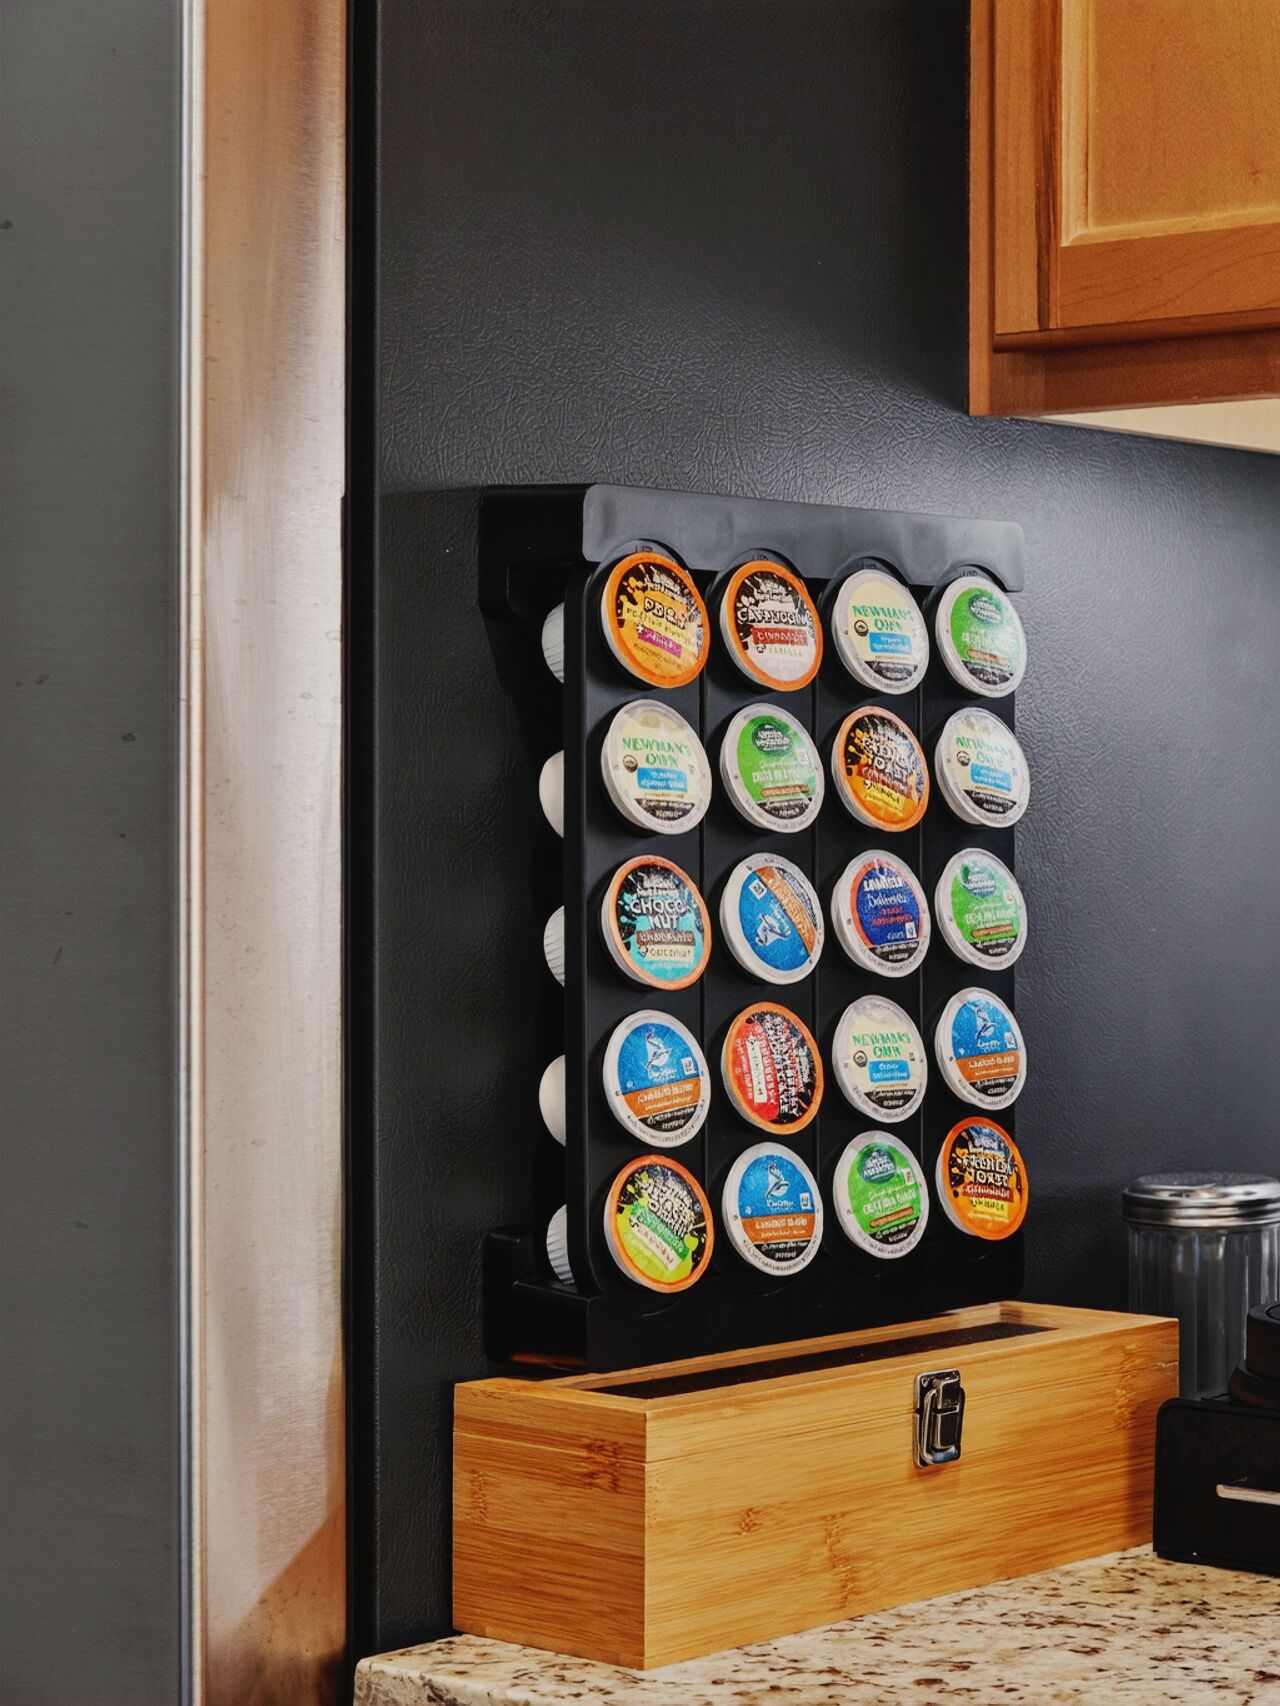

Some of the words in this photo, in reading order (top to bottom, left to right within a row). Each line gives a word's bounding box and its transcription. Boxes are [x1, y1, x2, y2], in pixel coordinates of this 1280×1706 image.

[645, 753, 679, 767] OWN
[630, 898, 686, 914] CHOCO
[649, 914, 680, 929] NUT
[873, 1046, 901, 1058] OWN
